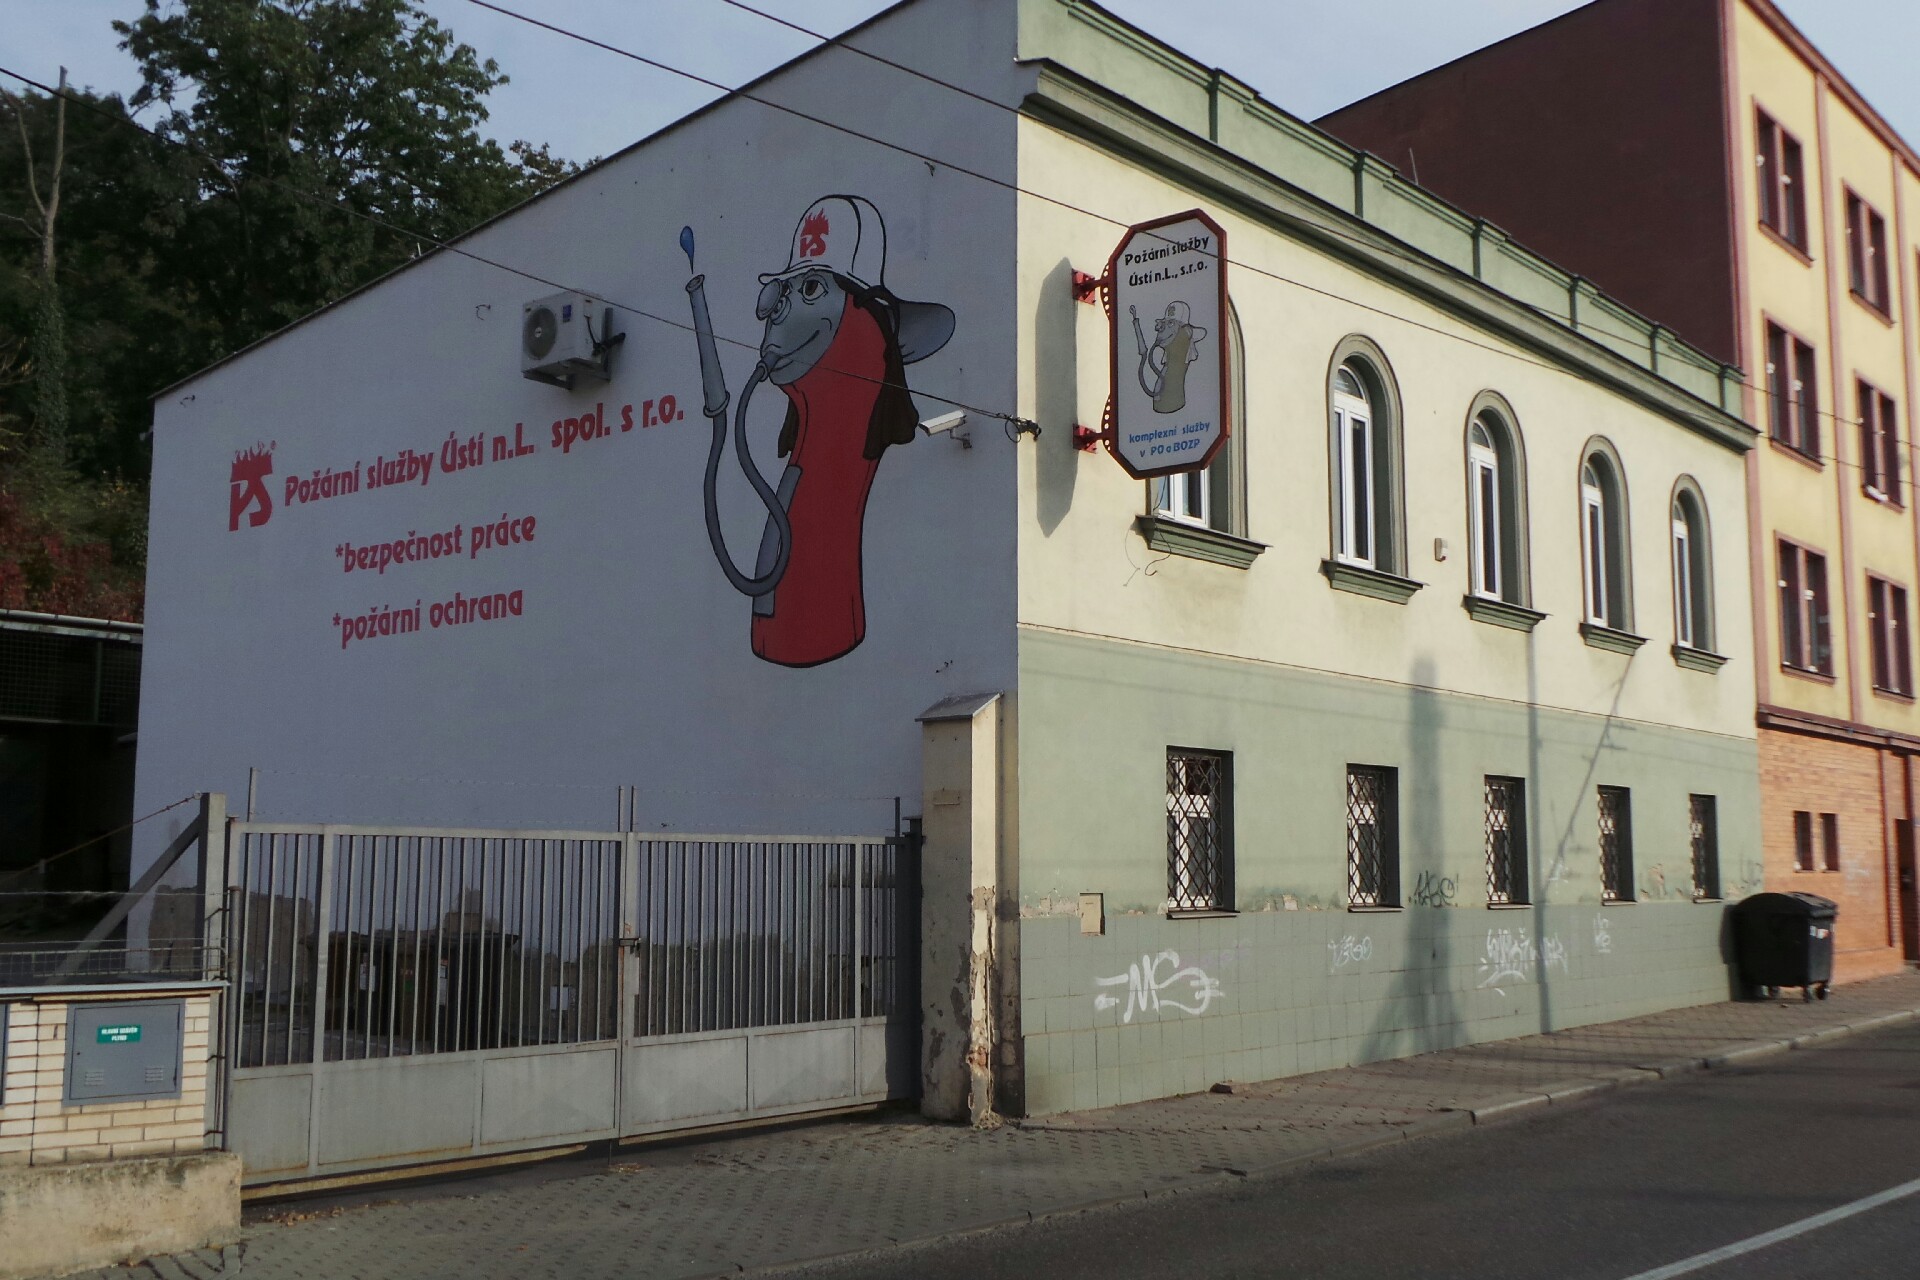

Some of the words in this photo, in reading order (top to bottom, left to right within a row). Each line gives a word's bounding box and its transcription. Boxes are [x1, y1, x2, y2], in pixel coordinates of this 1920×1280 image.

[1124, 244, 1170, 266] Požární
[1172, 236, 1209, 255] služby
[1129, 271, 1152, 287] Ústí
[1180, 260, 1208, 276] s.r.o.
[1129, 426, 1177, 444] komplexní
[1182, 421, 1210, 435] služby
[1151, 444, 1164, 456] PO
[1173, 439, 1200, 452] BOZP
[285, 460, 361, 507] Požární
[367, 449, 434, 490] služby
[440, 431, 484, 473] Ústí
[492, 423, 535, 462] n.L.
[551, 402, 611, 454] spol.
[621, 404, 633, 432] s
[642, 394, 684, 428] r.o.
[470, 513, 536, 560] práce
[429, 591, 523, 629] ochrana
